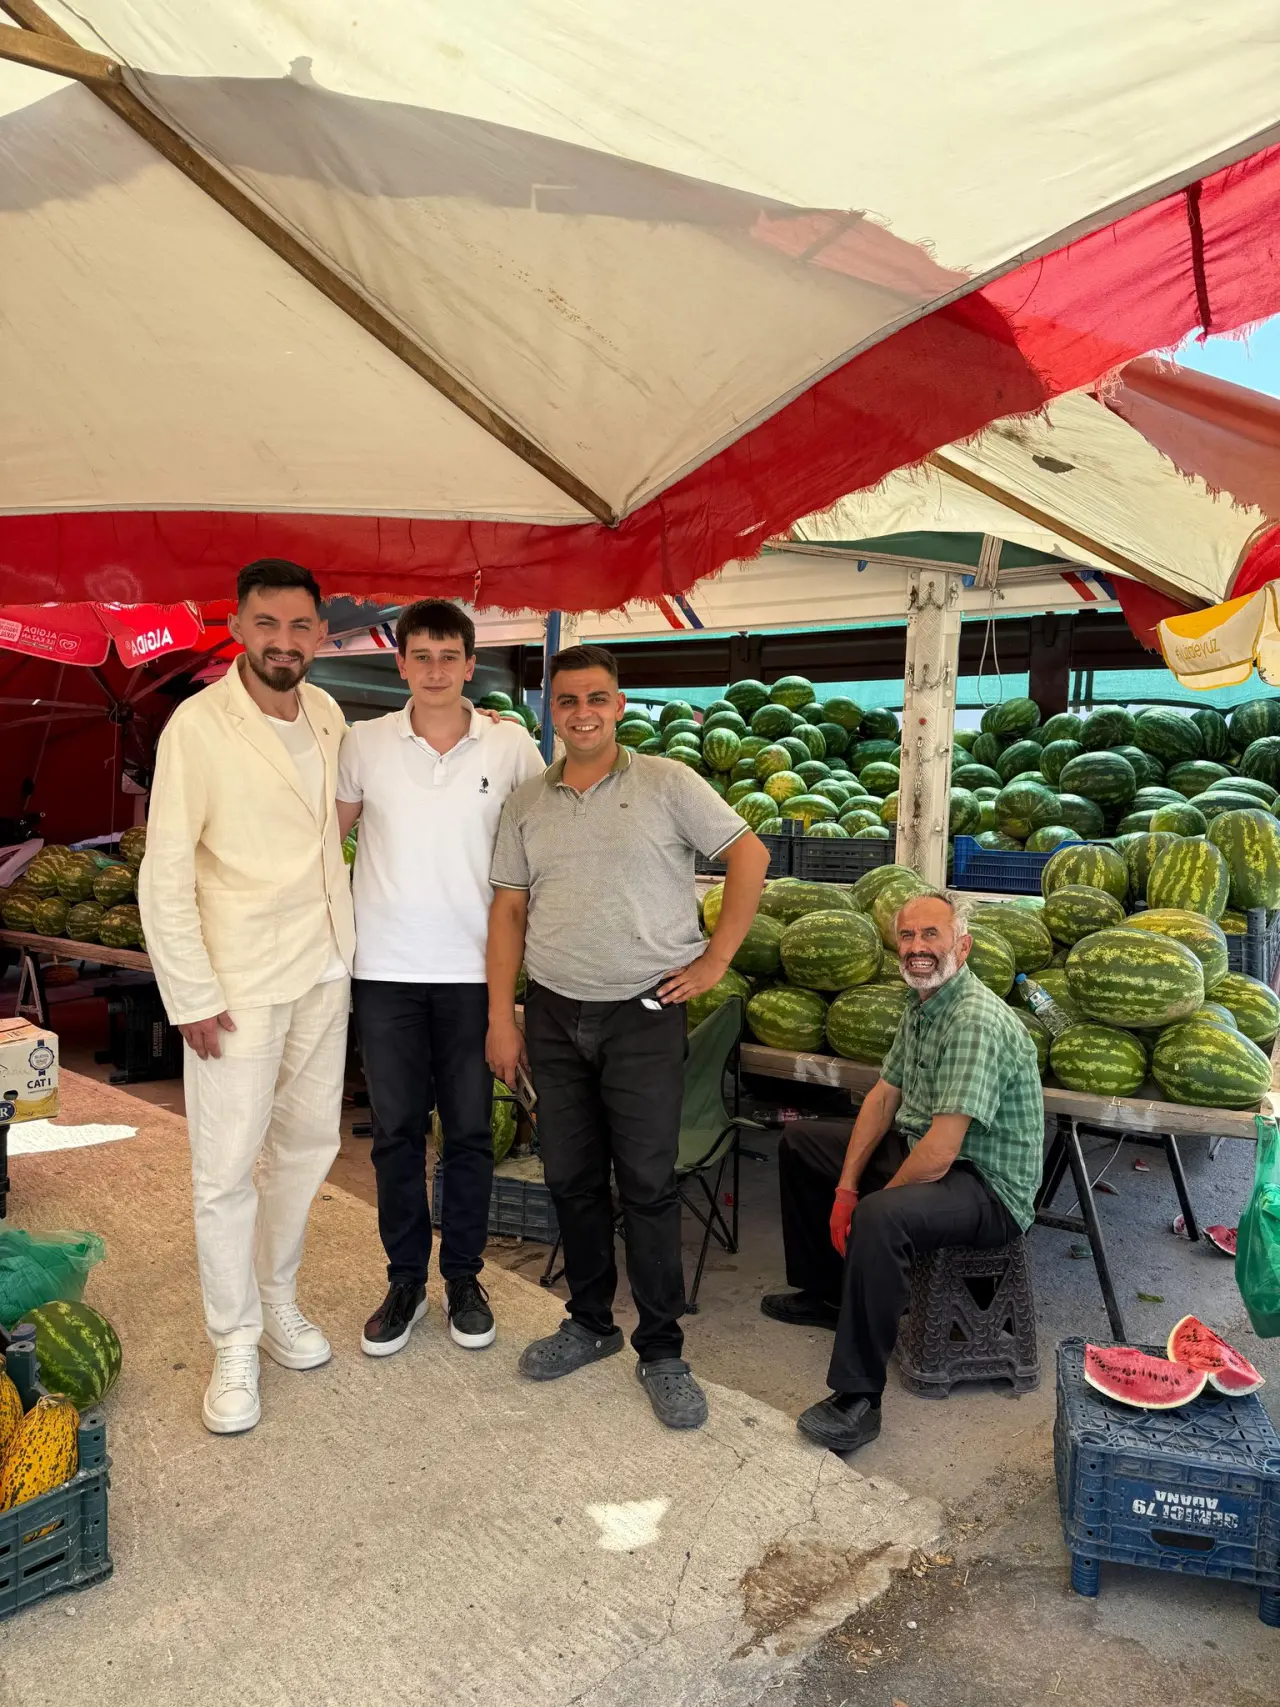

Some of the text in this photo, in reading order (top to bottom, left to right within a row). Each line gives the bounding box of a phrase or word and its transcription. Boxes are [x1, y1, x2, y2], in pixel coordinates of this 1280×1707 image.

[27, 1078, 46, 1089] CAT
[1132, 1499, 1157, 1516] 79
[1155, 1490, 1219, 1510] ADANA
